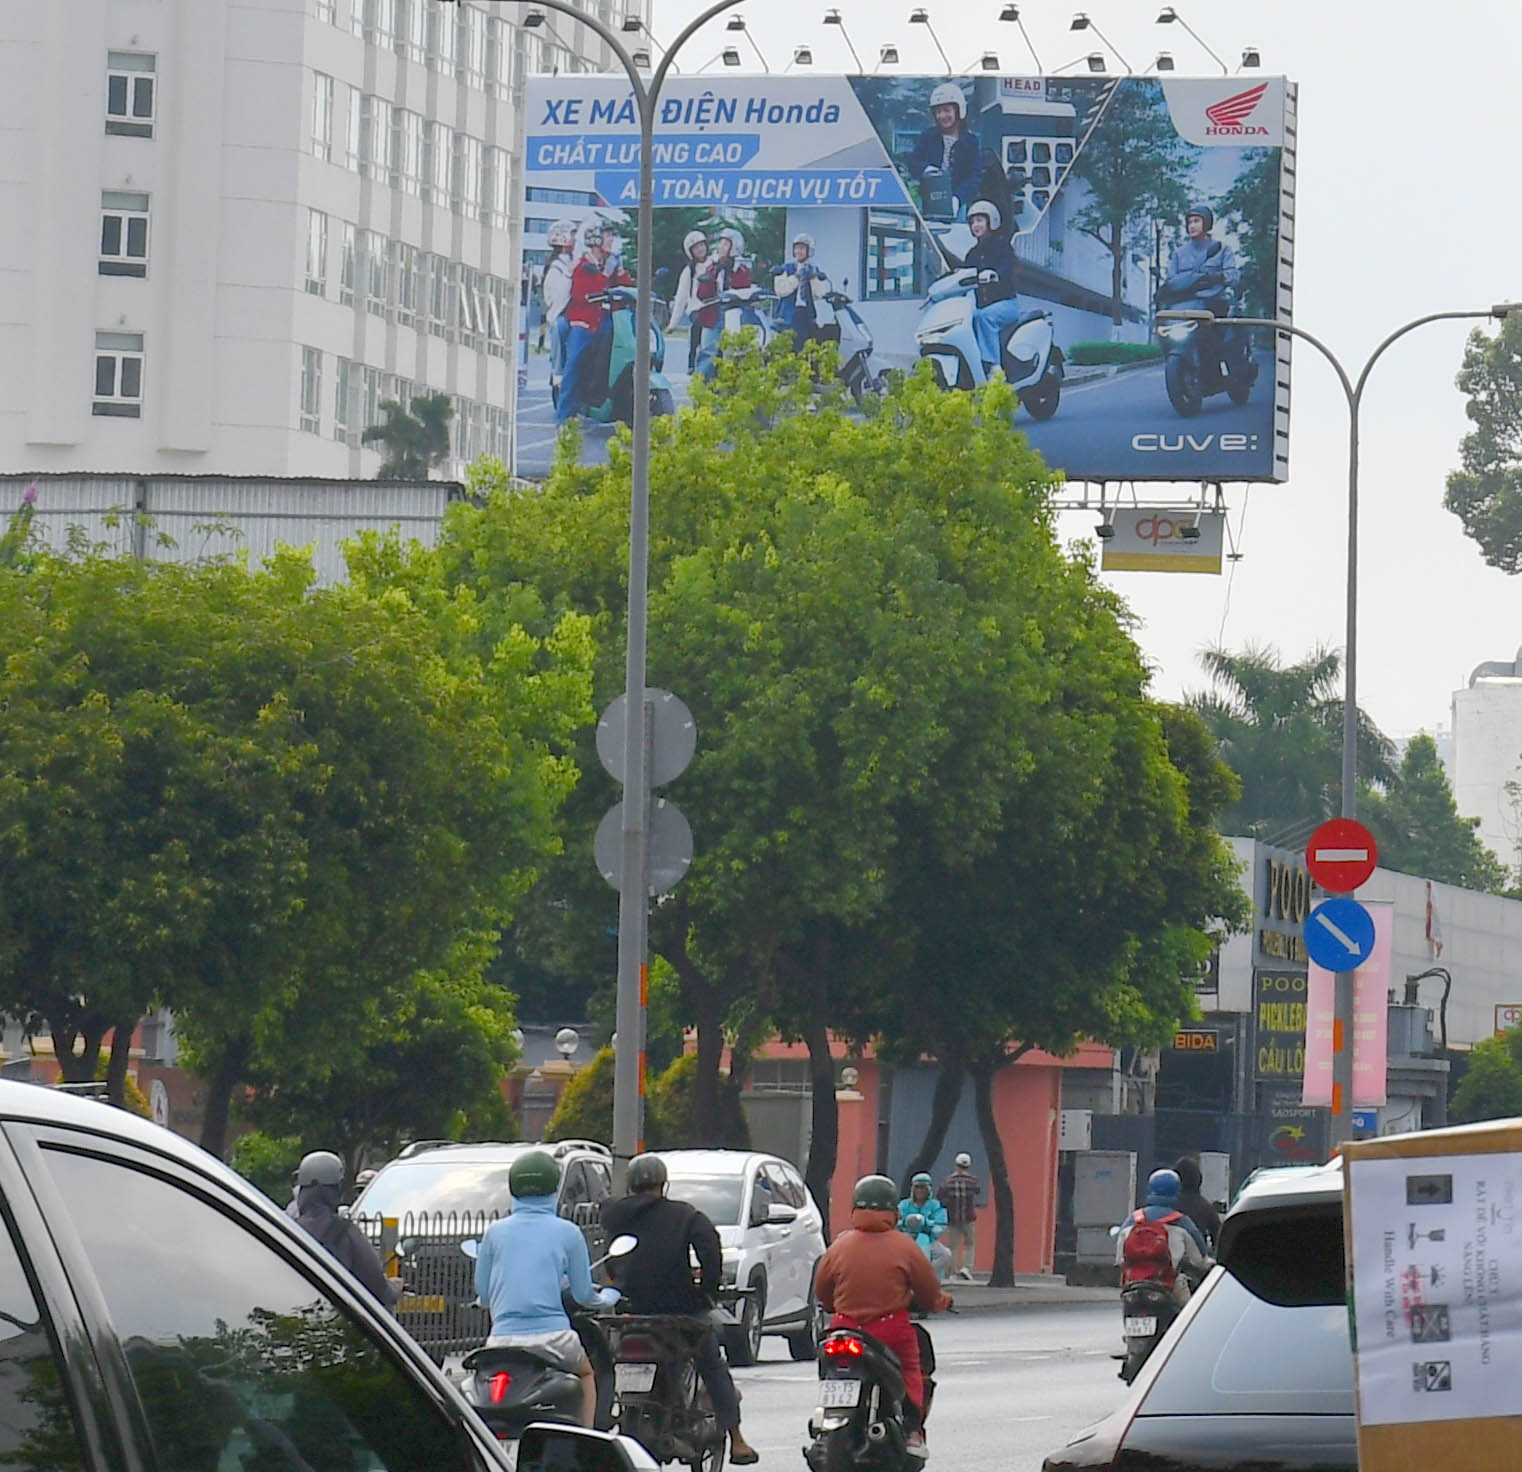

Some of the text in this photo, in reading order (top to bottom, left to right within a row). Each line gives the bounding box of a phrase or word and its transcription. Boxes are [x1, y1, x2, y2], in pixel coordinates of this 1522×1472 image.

[1003, 79, 1041, 91] HEAD
[541, 98, 583, 125] XE
[661, 91, 737, 131] ĐIỆN
[744, 97, 840, 125] Honda
[1205, 126, 1269, 136] HONDA
[538, 136, 602, 165] CHẤT
[694, 141, 743, 164] CAO
[661, 173, 729, 203] TOÀN,
[735, 177, 793, 205] DỊCH
[799, 177, 832, 204] VỤ
[836, 168, 881, 200] TỐT
[1259, 1002, 1307, 1032] PICKLEB
[1175, 1034, 1216, 1049] BIDA
